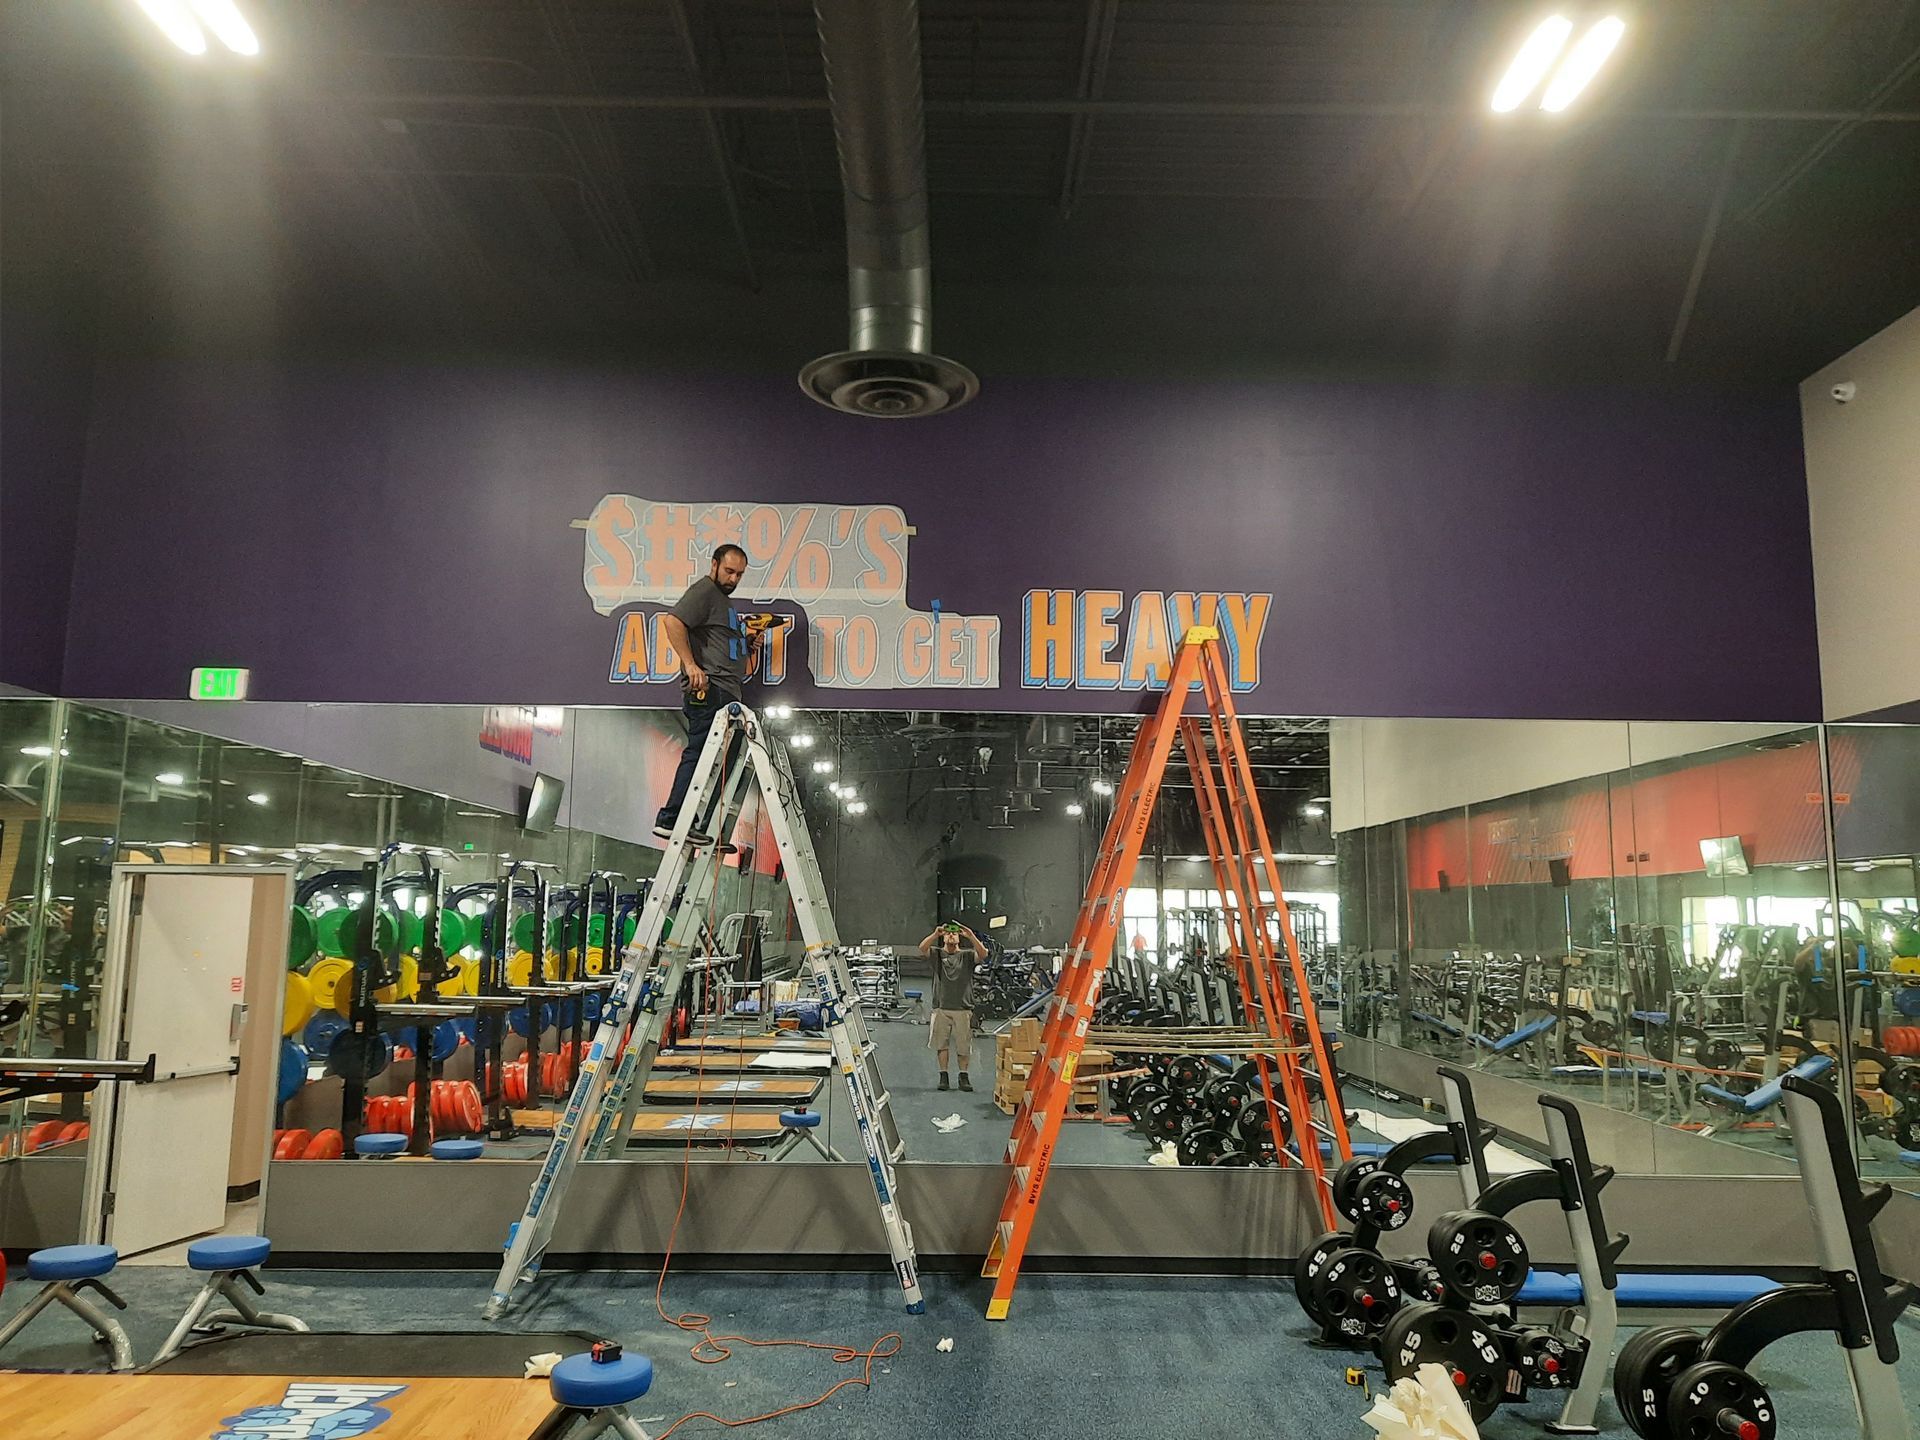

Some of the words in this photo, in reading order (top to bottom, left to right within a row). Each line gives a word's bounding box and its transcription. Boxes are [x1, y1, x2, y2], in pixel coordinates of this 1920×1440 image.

[609, 611, 796, 686] ABT
[806, 614, 880, 687] TO
[897, 614, 999, 687] GET
[199, 669, 240, 698] EXIT
[1035, 1143, 1050, 1182] ELECTRIC
[1357, 1164, 1374, 1175] 25
[1387, 1178, 1401, 1189] 10
[1362, 1197, 1371, 1212] 10
[1450, 1232, 1465, 1254] 25
[1505, 1233, 1522, 1255] 25
[1308, 1249, 1328, 1278] 45
[1328, 1262, 1346, 1281] 35
[1384, 1275, 1398, 1297] 35
[1400, 1330, 1422, 1367] 45
[1471, 1330, 1499, 1364] 45
[1523, 1355, 1534, 1366] 5
[1550, 1374, 1560, 1385] 5
[1642, 1388, 1657, 1418] 25
[1689, 1382, 1709, 1405] 10
[1753, 1397, 1770, 1422] 10
